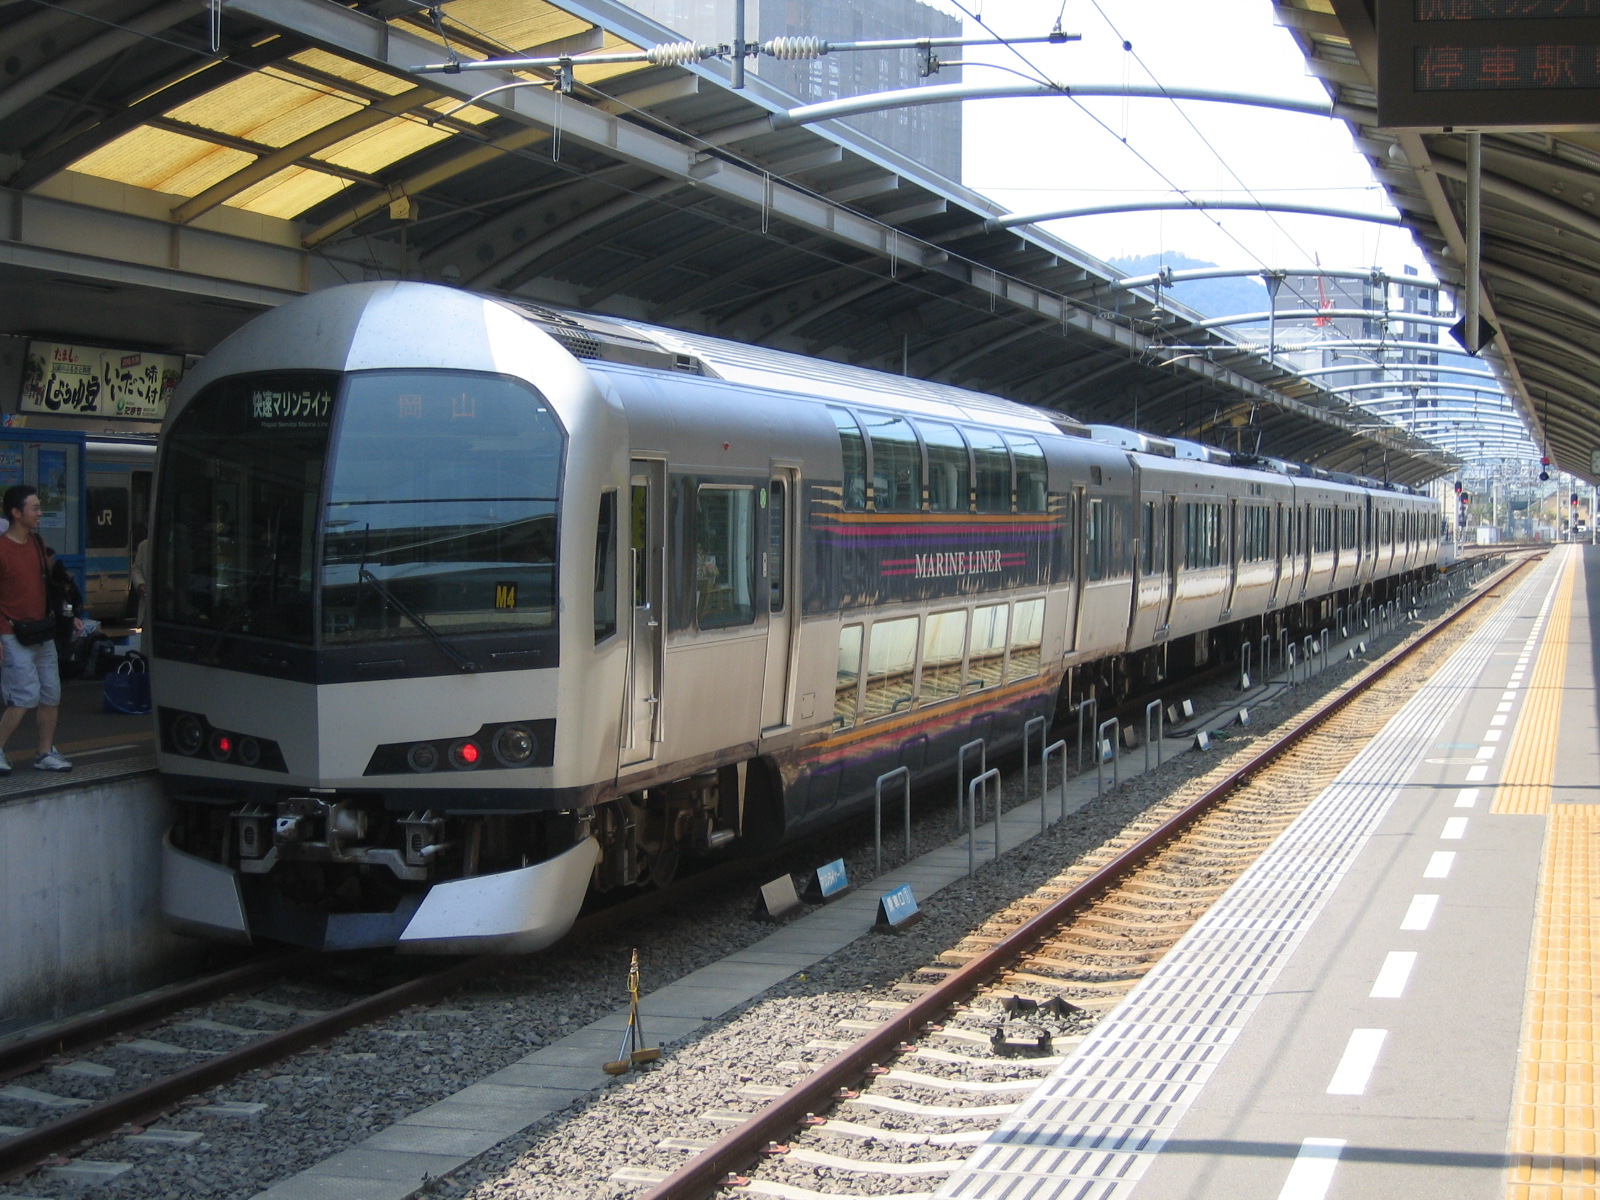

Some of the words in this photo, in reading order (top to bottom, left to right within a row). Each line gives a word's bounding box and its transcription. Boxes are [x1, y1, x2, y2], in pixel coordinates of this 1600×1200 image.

[1420, 44, 1600, 88] 停車駅
[97, 509, 112, 526] JR
[914, 551, 966, 579] MARINE
[968, 549, 1002, 574] LINER
[495, 585, 515, 609] M4
